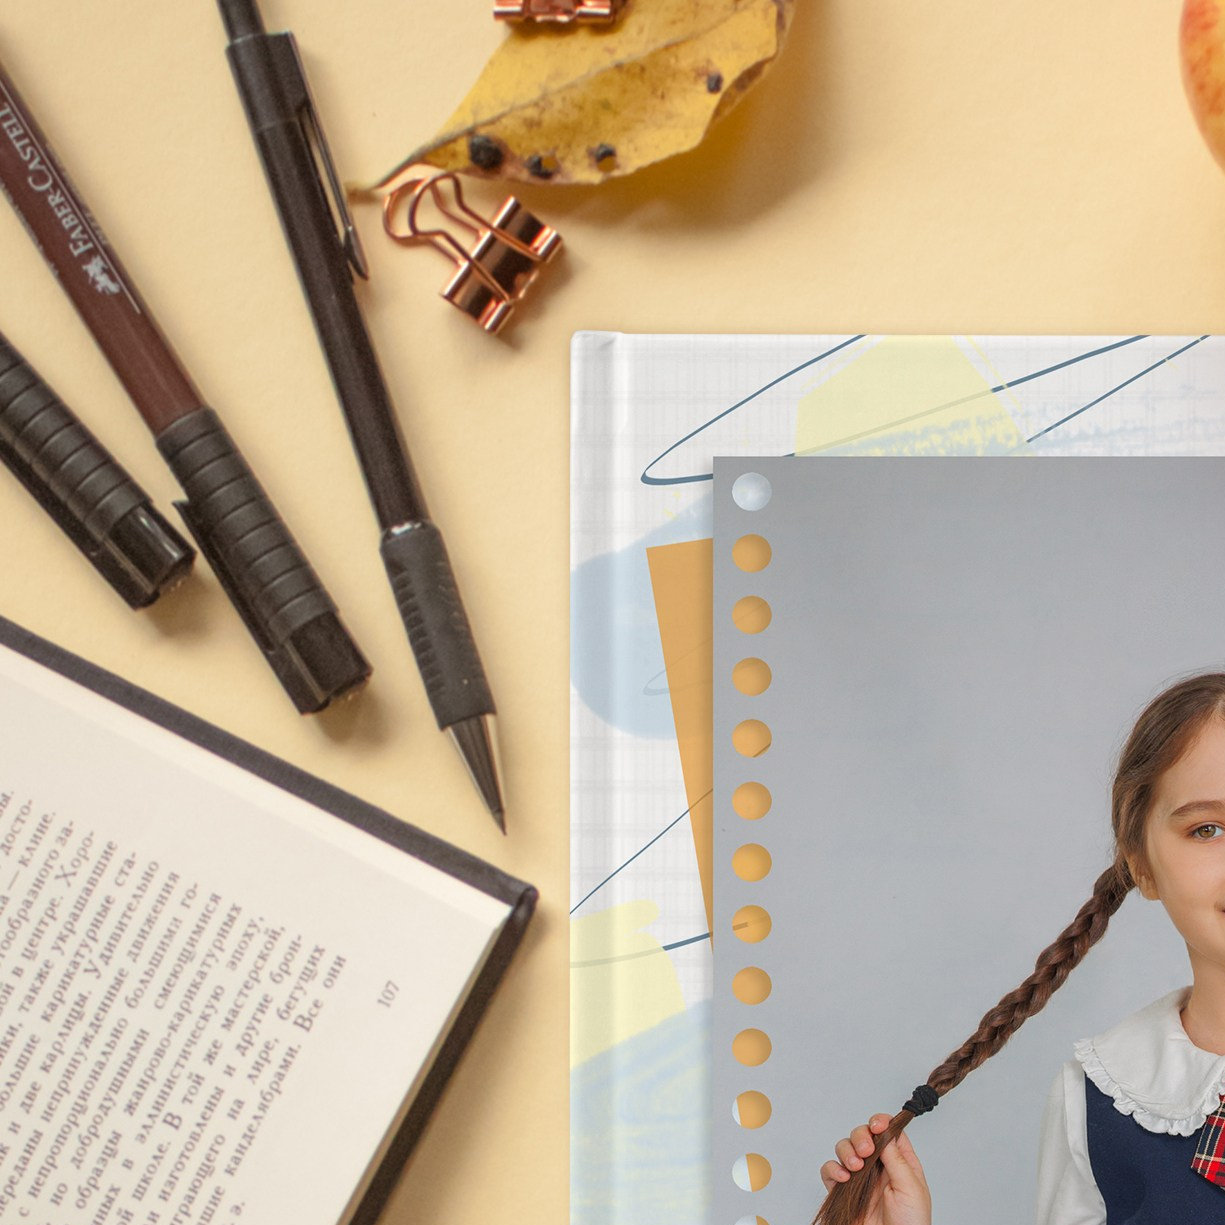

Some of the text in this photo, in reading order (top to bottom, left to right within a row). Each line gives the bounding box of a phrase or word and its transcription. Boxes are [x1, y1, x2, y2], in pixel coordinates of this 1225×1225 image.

[11, 966, 24, 979] в
[20, 896, 64, 961] центре.
[54, 831, 94, 888] Хоро-
[17, 812, 56, 868] клине.
[17, 959, 54, 1013] также
[50, 840, 118, 956] украшавшие
[40, 895, 116, 1023] карикатурные
[114, 852, 136, 888] ста-
[55, 820, 74, 847] за-
[7, 1121, 22, 1135] и
[19, 1081, 42, 1115] две
[39, 991, 92, 1074] карлицы.
[82, 861, 160, 980] Удивительно
[18, 1206, 30, 1218] с
[27, 1017, 129, 1199] непропорционально
[124, 916, 183, 1009] большими
[179, 882, 198, 910] го-
[39, 967, 129, 1123] непринужденные
[126, 871, 180, 964] движения
[49, 1182, 69, 1207] но
[70, 1028, 150, 1171] добродушными
[154, 892, 222, 1010] смеющимися
[74, 1129, 123, 1210] образцы
[123, 903, 243, 1117] жанрово-карикатурных
[121, 1158, 135, 1171] в
[134, 984, 225, 1145] эллинистическую
[225, 916, 265, 971] эпоху,
[131, 1141, 171, 1202] школе.
[161, 1111, 183, 1131] В
[181, 1071, 206, 1105] той
[202, 1039, 223, 1067] же
[220, 926, 286, 1032] мастерской,
[157, 1085, 225, 1203] изготовлены
[223, 1063, 237, 1078] и
[234, 993, 274, 1058] другие
[269, 934, 302, 985] брон-
[223, 1044, 302, 1177] канделябрами.
[292, 999, 324, 1033] Все
[322, 955, 347, 989] они
[226, 1098, 246, 1121] на
[246, 1037, 279, 1085] лире,
[275, 944, 326, 1021] бегущих
[376, 980, 400, 1008] 107
[229, 1201, 246, 1216] э.
